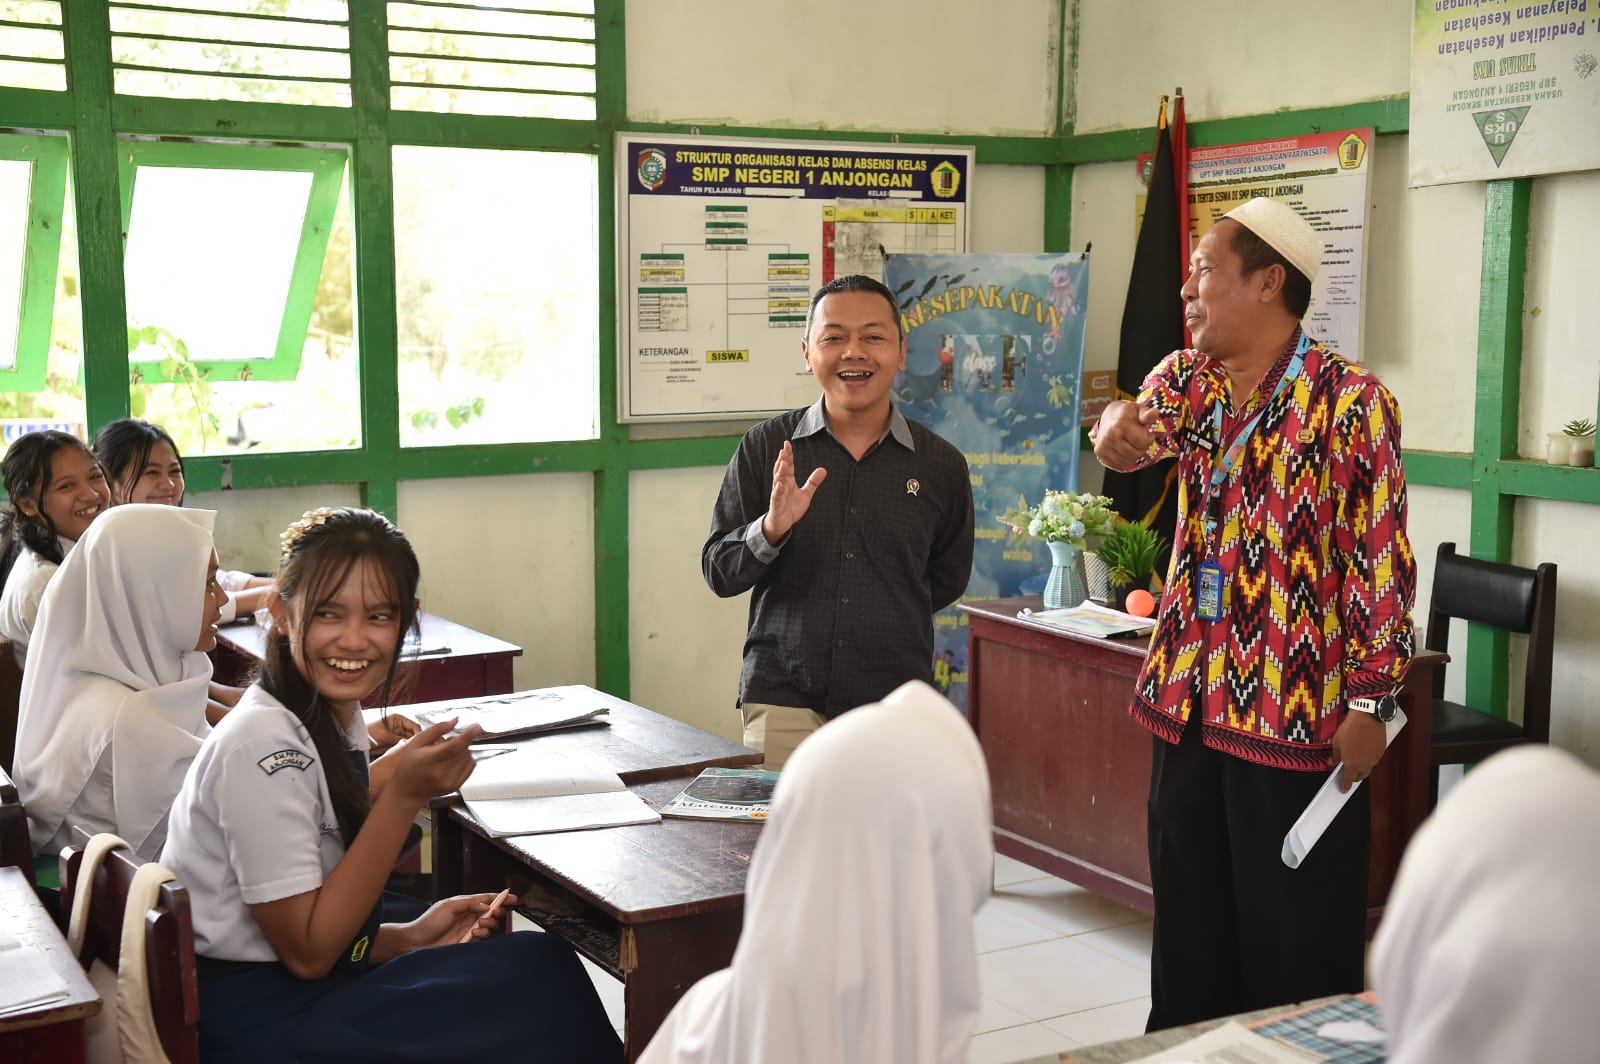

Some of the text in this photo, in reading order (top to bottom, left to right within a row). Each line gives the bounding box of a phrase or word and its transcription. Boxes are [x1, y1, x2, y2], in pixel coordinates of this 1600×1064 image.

[1444, 0, 1587, 32] Pelayanan Kesehatan
[1510, 20, 1585, 43] Pendidikan
[1438, 34, 1505, 55] Kesehatan
[1473, 53, 1536, 80] TRIAS UKS
[1453, 77, 1557, 101] SMP NEGERI 1 ANJONGAN
[1446, 89, 1563, 113] USAHA KESEHATAN SEKOLAH
[1484, 121, 1517, 135] UKS
[676, 151, 731, 165] STRUKTUR
[734, 153, 796, 167] ORGANISASI
[798, 156, 830, 168] KELAS
[832, 157, 852, 169] DAN
[854, 158, 895, 170] ABSENSI
[897, 160, 927, 171] KELAS
[1288, 147, 1328, 159] PARIWISATA
[692, 166, 913, 188] SMP NEGERI 1 ANJONGAN
[1212, 169, 1224, 178] SMP
[1225, 166, 1247, 176] NEGERI
[1253, 162, 1286, 172] ANJONGAN
[704, 186, 742, 194] PELAJARAN
[1239, 188, 1250, 200] SMP
[1251, 186, 1270, 198] NEGERI
[1275, 184, 1304, 197] ANJONGAN
[901, 284, 1063, 335] KESEPAKATAN
[639, 347, 689, 357] KETERANGAN
[711, 352, 744, 361] SISWA
